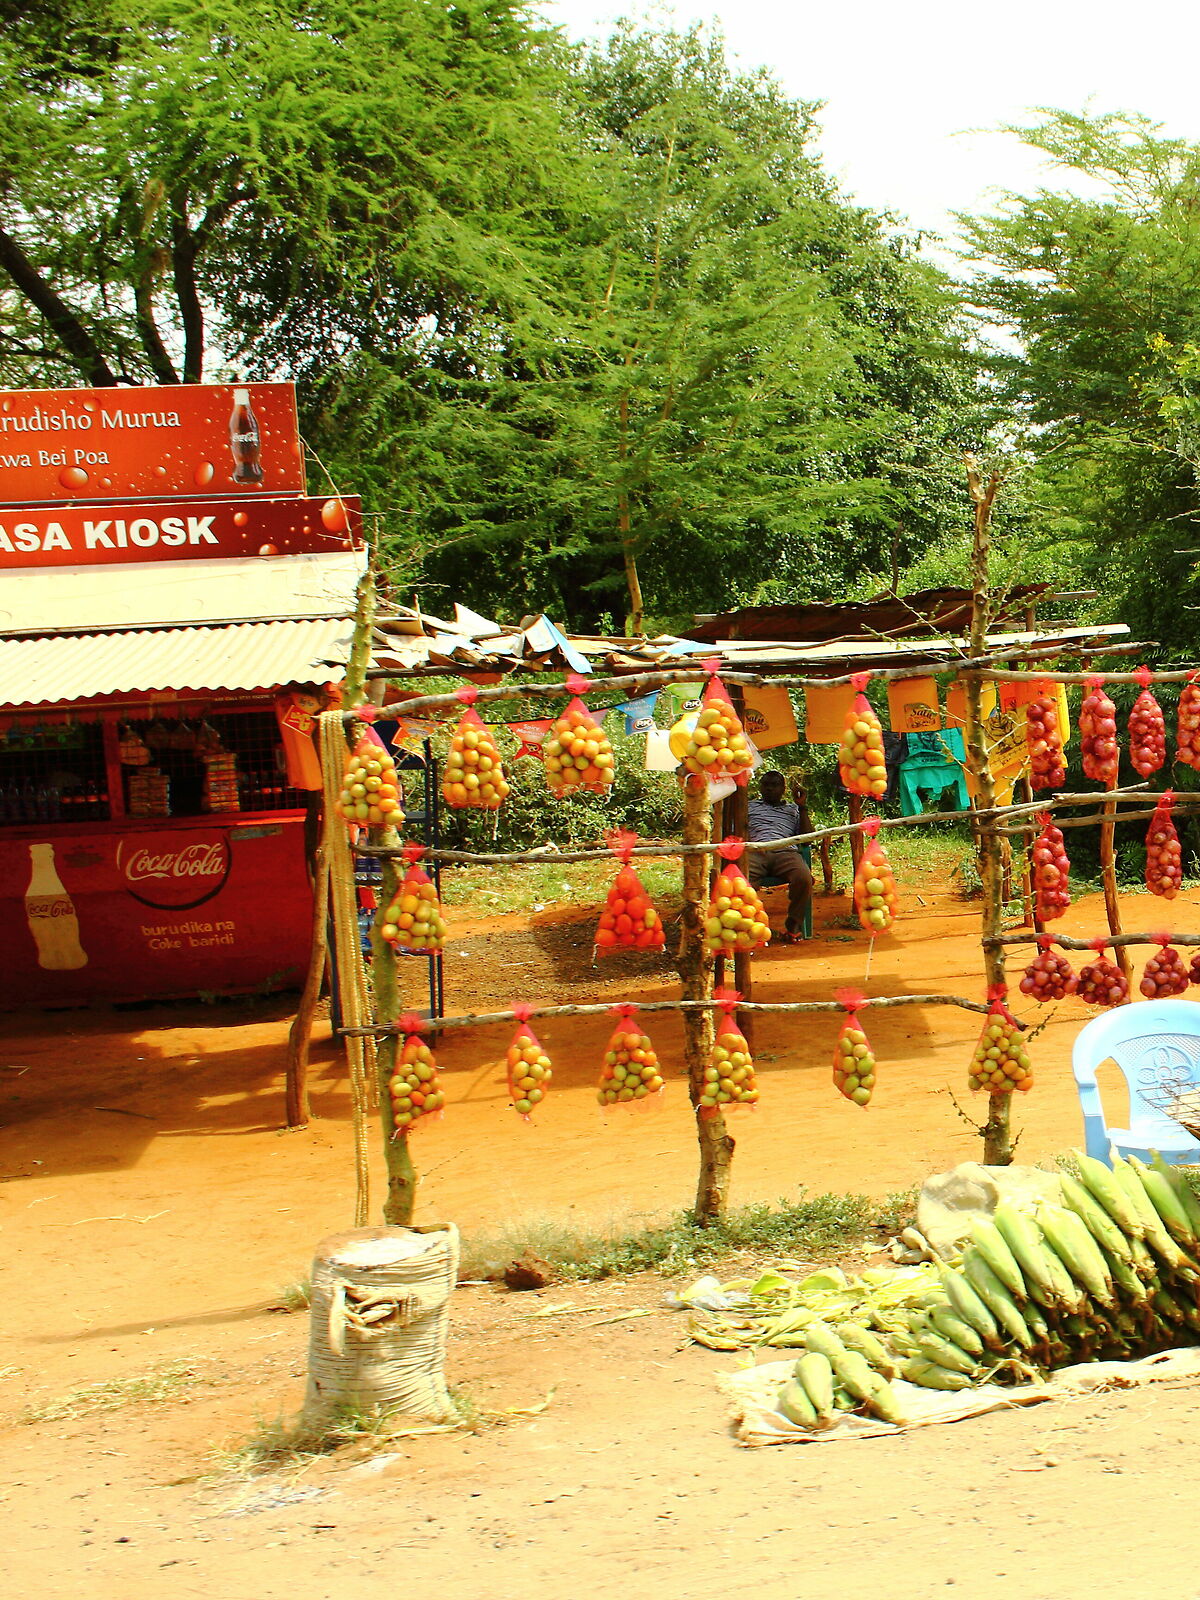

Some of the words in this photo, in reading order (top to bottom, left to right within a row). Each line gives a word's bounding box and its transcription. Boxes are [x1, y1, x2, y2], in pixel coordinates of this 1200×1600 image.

[0, 407, 92, 433] rudisho
[101, 410, 181, 429] Murua
[38, 450, 67, 466] Bei
[74, 449, 110, 465] Poa
[83, 516, 219, 549] KIOSK
[126, 842, 225, 881] Coca-Cola
[141, 922, 213, 936] burudika
[217, 921, 235, 931] na
[150, 938, 182, 950] Coke
[189, 934, 235, 947] baridi
